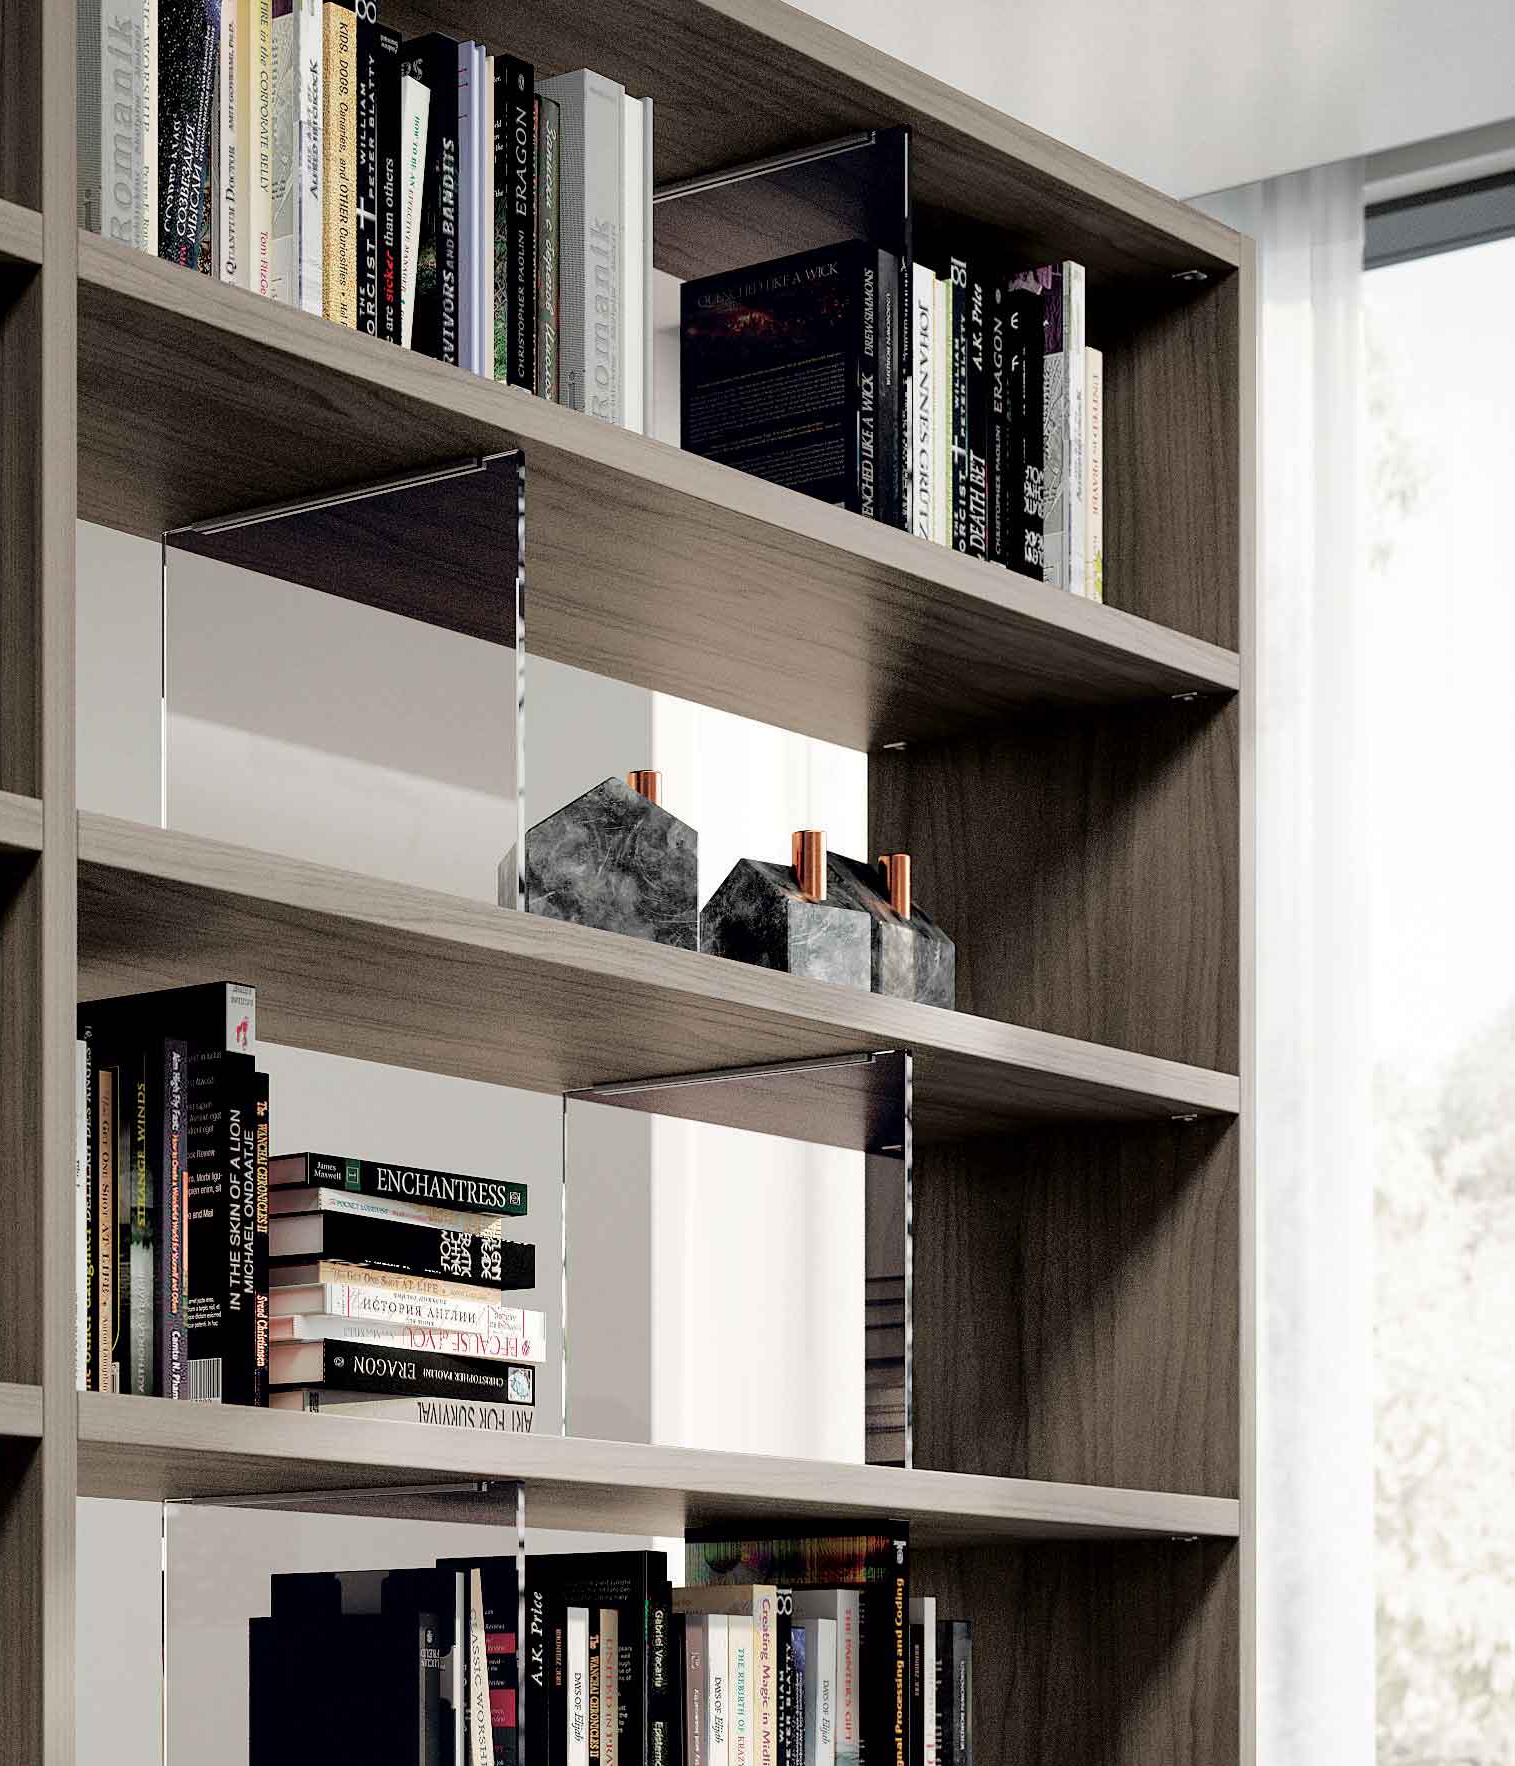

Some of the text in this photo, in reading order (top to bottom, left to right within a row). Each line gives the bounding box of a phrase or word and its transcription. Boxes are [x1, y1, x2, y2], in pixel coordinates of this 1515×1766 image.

[258, 1, 270, 195] FIRE in the CORPORATE BELLY
[339, 22, 350, 287] KIDS, DOGS, Canaries, and OTHER Curiosities
[514, 106, 528, 217] ERAGON
[516, 228, 525, 378] CHRISTOPHER PAOLINI
[993, 317, 1003, 414] ERAGON
[969, 449, 987, 552] DEATH BET
[136, 1081, 146, 1228] STRANGE WINDS
[313, 1161, 342, 1182] James Maxwell
[376, 1166, 506, 1209] ENCHANTRESS
[229, 1109, 241, 1311] IN THE SKIN OF A LION
[243, 1129, 255, 1295] MICHAEL ONDAATJE
[354, 1356, 418, 1380] ERAGON
[423, 1367, 505, 1388] CHRISTOPHER PAOLINI
[529, 1591, 544, 1687] A.K. Price
[759, 1597, 772, 1660] Creating
[893, 1577, 905, 1626] Coding
[468, 1606, 483, 1687] CLASSIC
[653, 1609, 664, 1688] Gabriel Vacariu
[893, 1629, 904, 1657] and
[572, 1671, 584, 1744] DAYS OF Elijah
[759, 1663, 772, 1705] Magic
[761, 1711, 772, 1725] in
[893, 1660, 905, 1734] Processing
